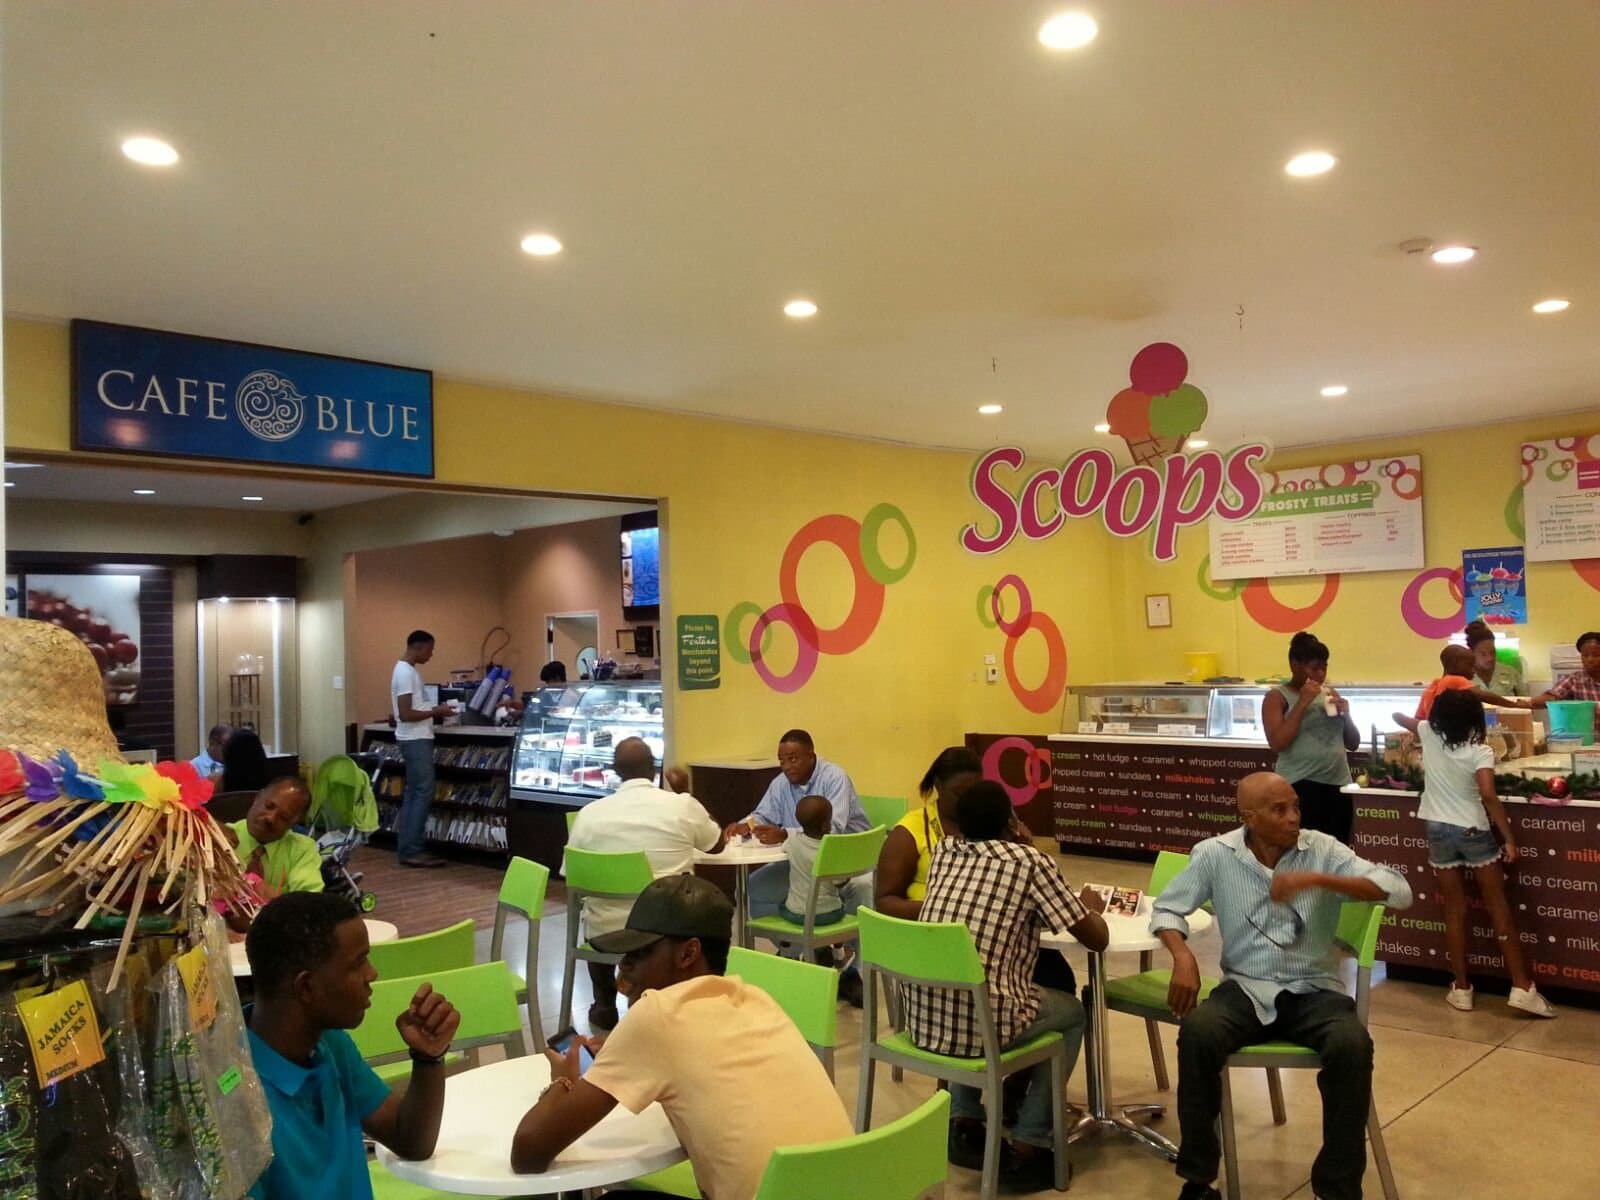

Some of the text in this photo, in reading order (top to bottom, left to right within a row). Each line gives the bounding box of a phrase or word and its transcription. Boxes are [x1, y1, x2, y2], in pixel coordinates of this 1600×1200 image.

[97, 369, 419, 440] CAFE BLUE
[961, 444, 1266, 561] Scoops
[1261, 493, 1359, 512] FROSTY TREATS
[1093, 753, 1105, 761] hot
[1107, 753, 1129, 764] fudge
[1142, 756, 1175, 764] caramel
[1189, 759, 1226, 768] whipped
[1228, 760, 1256, 769] cream
[1082, 770, 1106, 778] cream
[1118, 771, 1152, 781] sundaes
[1165, 774, 1216, 785] milkshakes
[1098, 787, 1129, 796] caramel
[1155, 792, 1182, 800] cream
[1195, 793, 1209, 802] hot
[1211, 794, 1237, 806] fudge
[1063, 802, 1087, 810] cream
[1151, 808, 1184, 818] caramel
[1198, 812, 1237, 822] whipped
[1356, 807, 1585, 832] cream caramel
[1081, 820, 1106, 829] cream
[1119, 823, 1152, 833] sundaes
[1165, 826, 1212, 838] milkshakes
[1105, 839, 1136, 848] caramel
[1519, 872, 1598, 893] ice cream
[1401, 917, 1447, 932] cream
[1533, 960, 1558, 975] ice
[38, 1000, 85, 1050] JAMAICA
[52, 1016, 87, 1055] SOCKS
